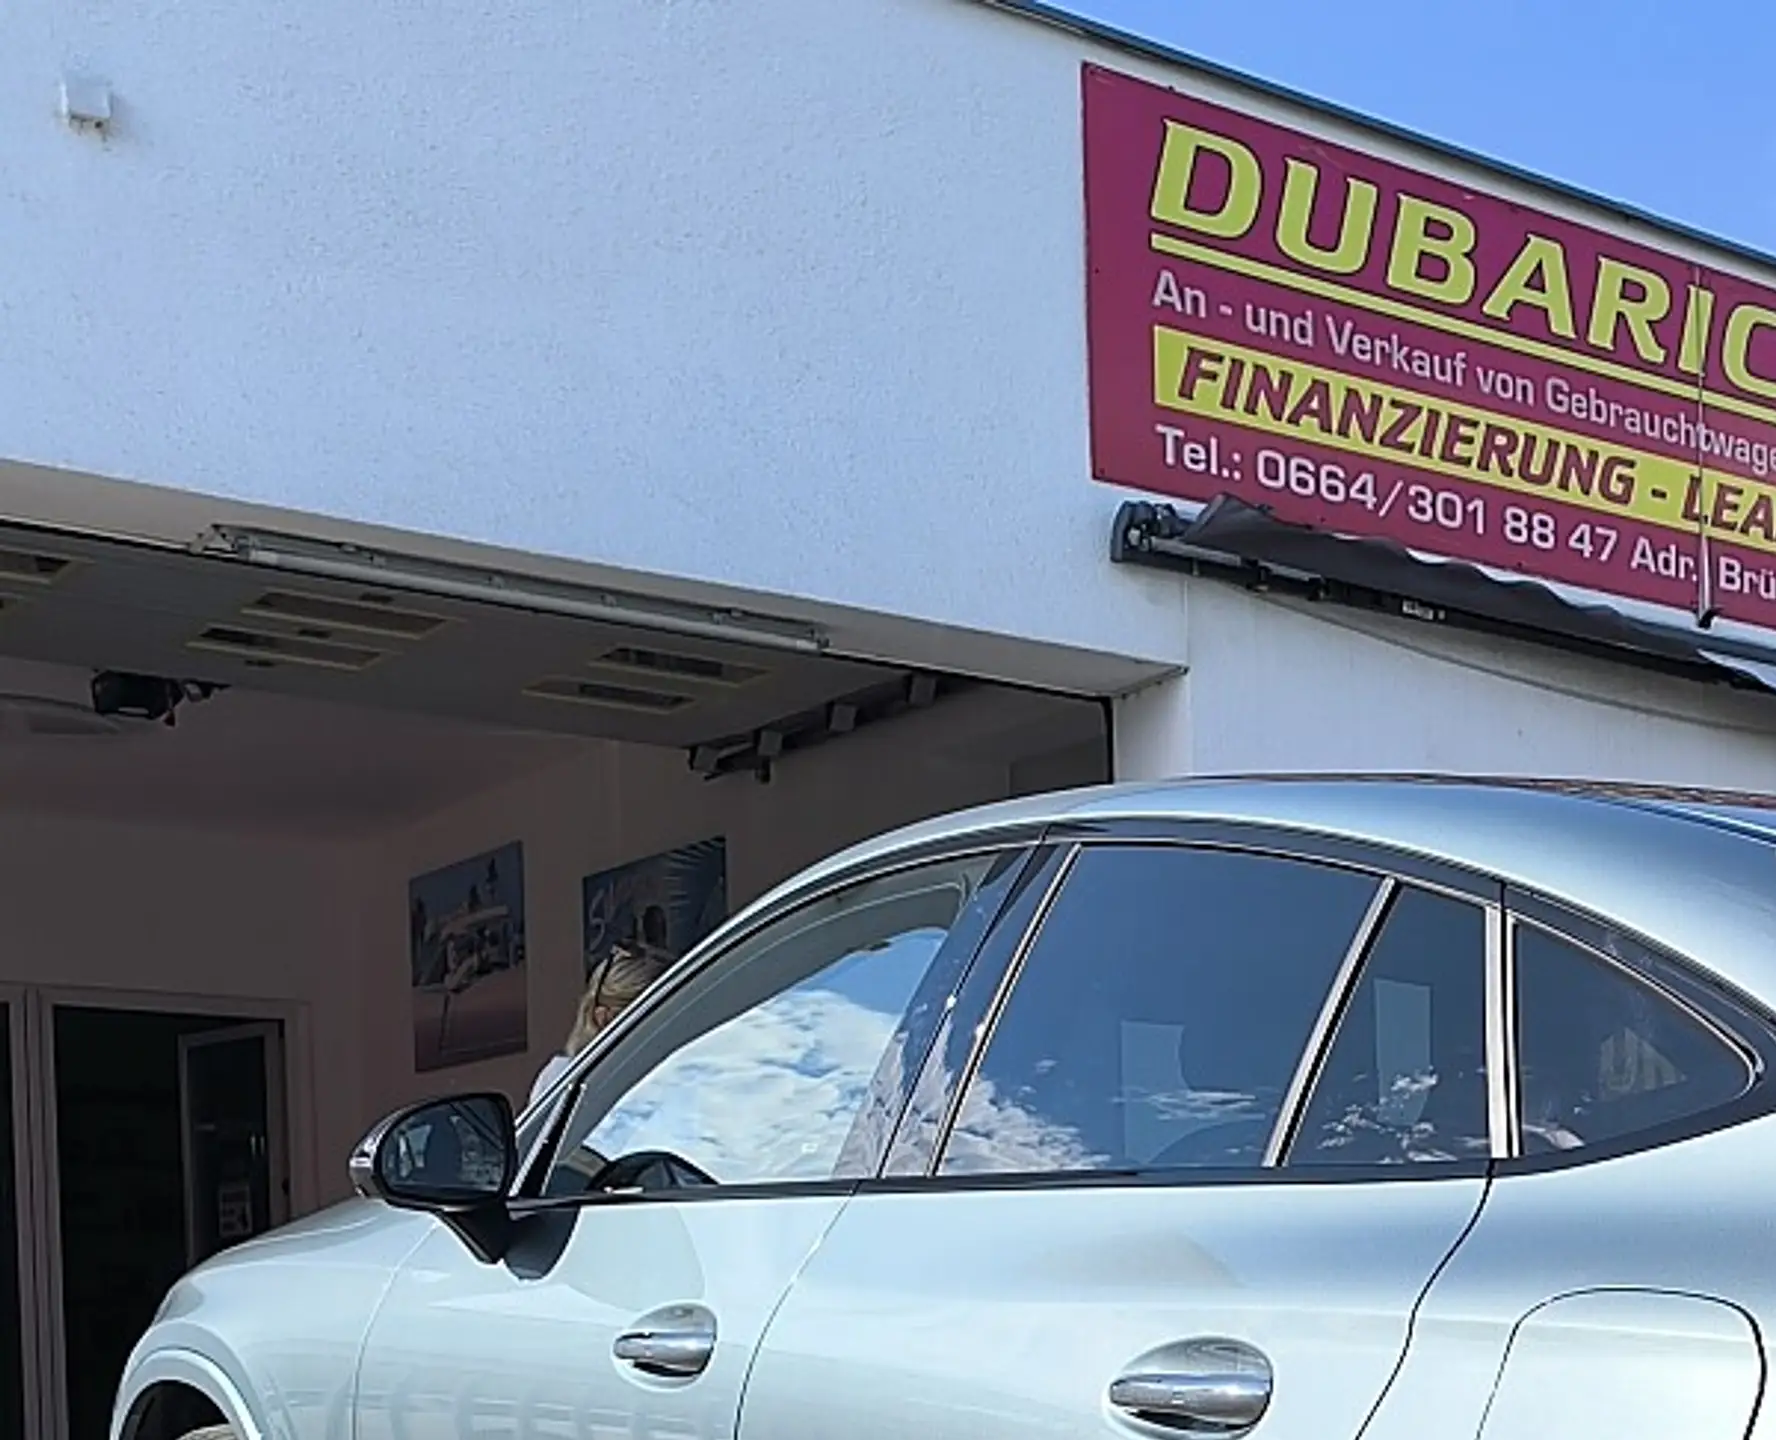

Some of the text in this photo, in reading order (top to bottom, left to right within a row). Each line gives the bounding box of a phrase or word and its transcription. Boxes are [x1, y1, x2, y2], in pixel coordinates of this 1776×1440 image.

[1152, 270, 1206, 318] An
[1245, 303, 1313, 347] und
[1326, 314, 1467, 387] Verkauf
[1477, 366, 1534, 407] von
[1156, 423, 1241, 481] Tel.:
[1257, 449, 1485, 535] 0664/301
[1504, 507, 1555, 549] 88
[1568, 523, 1617, 562] 47
[1178, 346, 1637, 506] FINANZIERUNG
